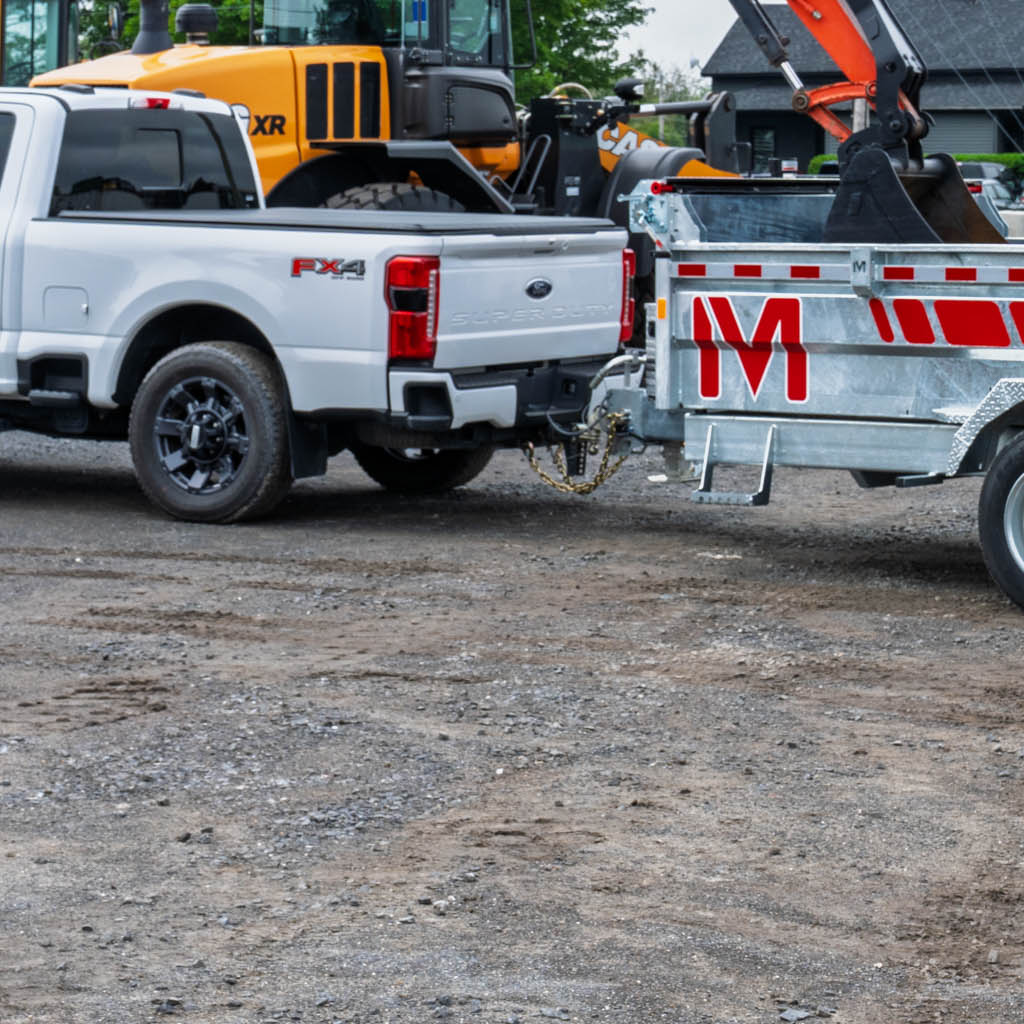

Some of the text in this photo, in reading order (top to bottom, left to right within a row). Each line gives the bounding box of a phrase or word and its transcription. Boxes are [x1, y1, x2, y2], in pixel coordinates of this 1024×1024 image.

[251, 114, 286, 136] XR
[596, 123, 660, 156] CA
[291, 257, 366, 277] FX4
[852, 260, 866, 273] M
[450, 303, 615, 326] SUPER DUTY
